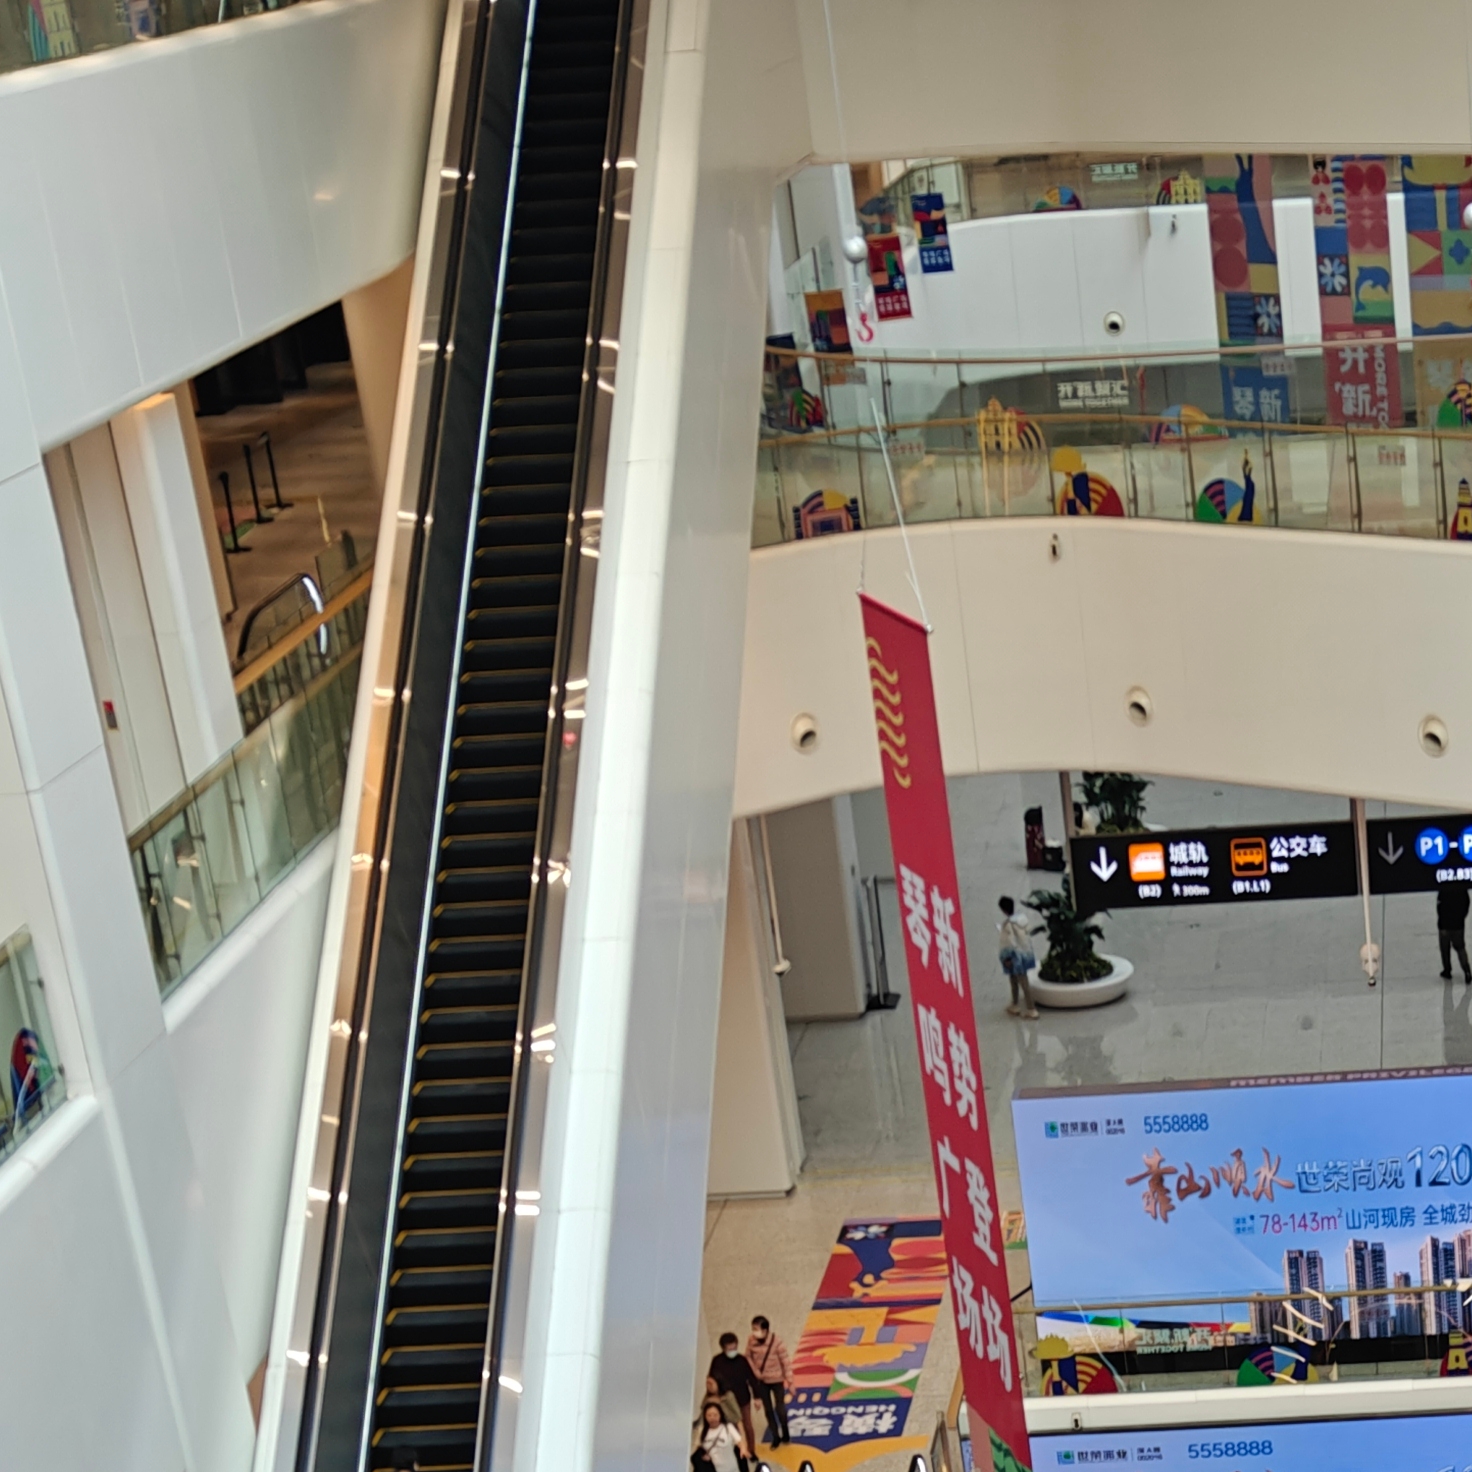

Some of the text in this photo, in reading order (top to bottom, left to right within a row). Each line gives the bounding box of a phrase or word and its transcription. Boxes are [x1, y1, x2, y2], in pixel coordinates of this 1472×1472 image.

[1169, 834, 1328, 865] 城轨 公交车
[1170, 861, 1289, 879] Railway Bus
[899, 863, 984, 1360] 琴鸣广场
[1144, 1113, 1209, 1135] 5558888
[930, 885, 1013, 1394] 新势登场
[1296, 1156, 1405, 1193] 世荣尚观
[1345, 1206, 1415, 1231] 山河现房
[788, 1404, 897, 1417] HENGQIN
[788, 1411, 898, 1437] 横琴
[1187, 1439, 1273, 1460] 5558888
